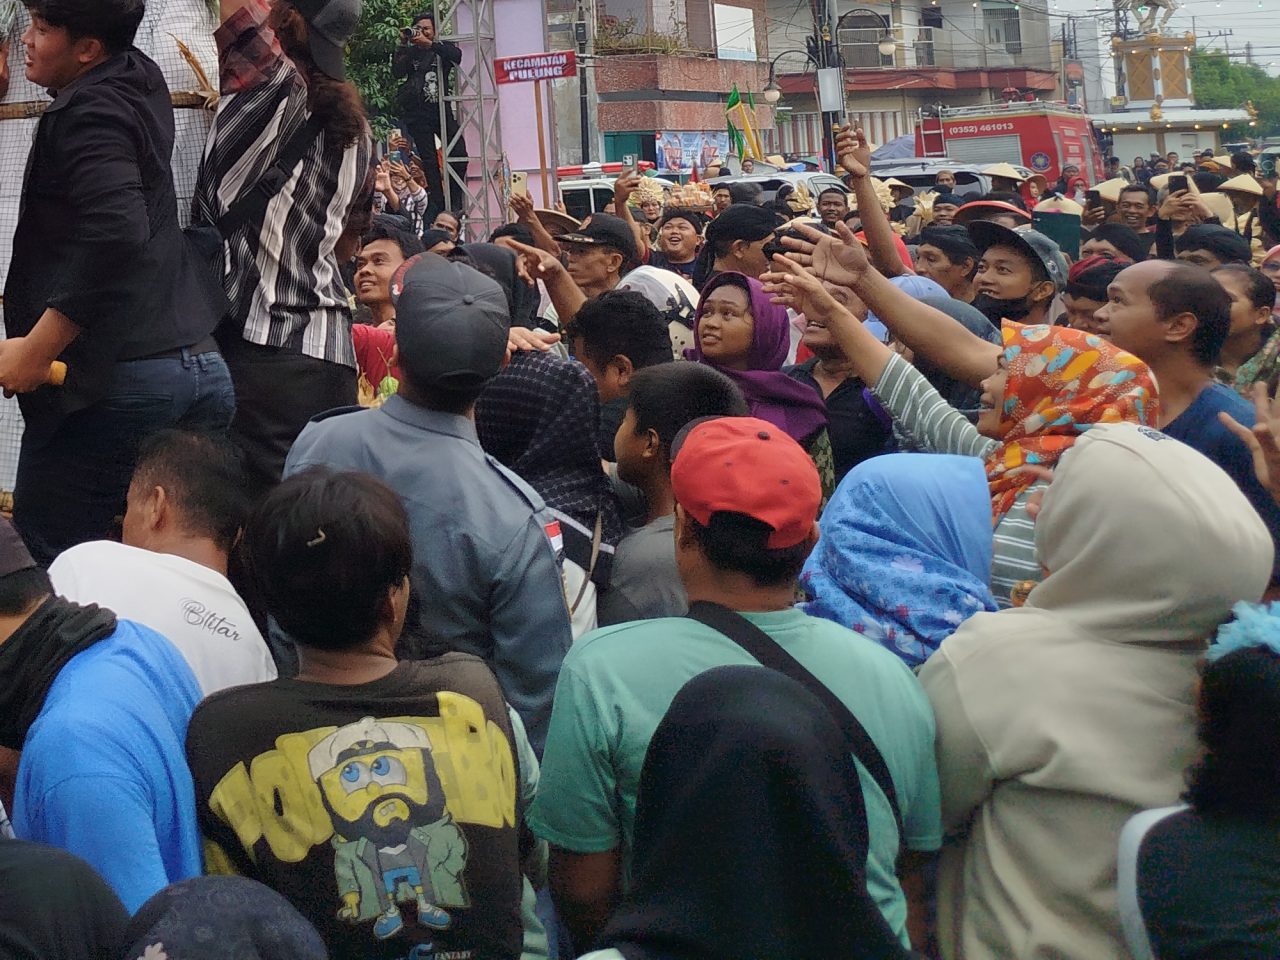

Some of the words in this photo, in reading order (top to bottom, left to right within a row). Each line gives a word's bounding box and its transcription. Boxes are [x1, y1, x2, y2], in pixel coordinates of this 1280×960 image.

[503, 54, 567, 71] KECAMATAN
[509, 66, 563, 81] PULUNG
[949, 126, 979, 136] (0352)
[979, 122, 1014, 132] 461013
[180, 598, 242, 641] Blitar
